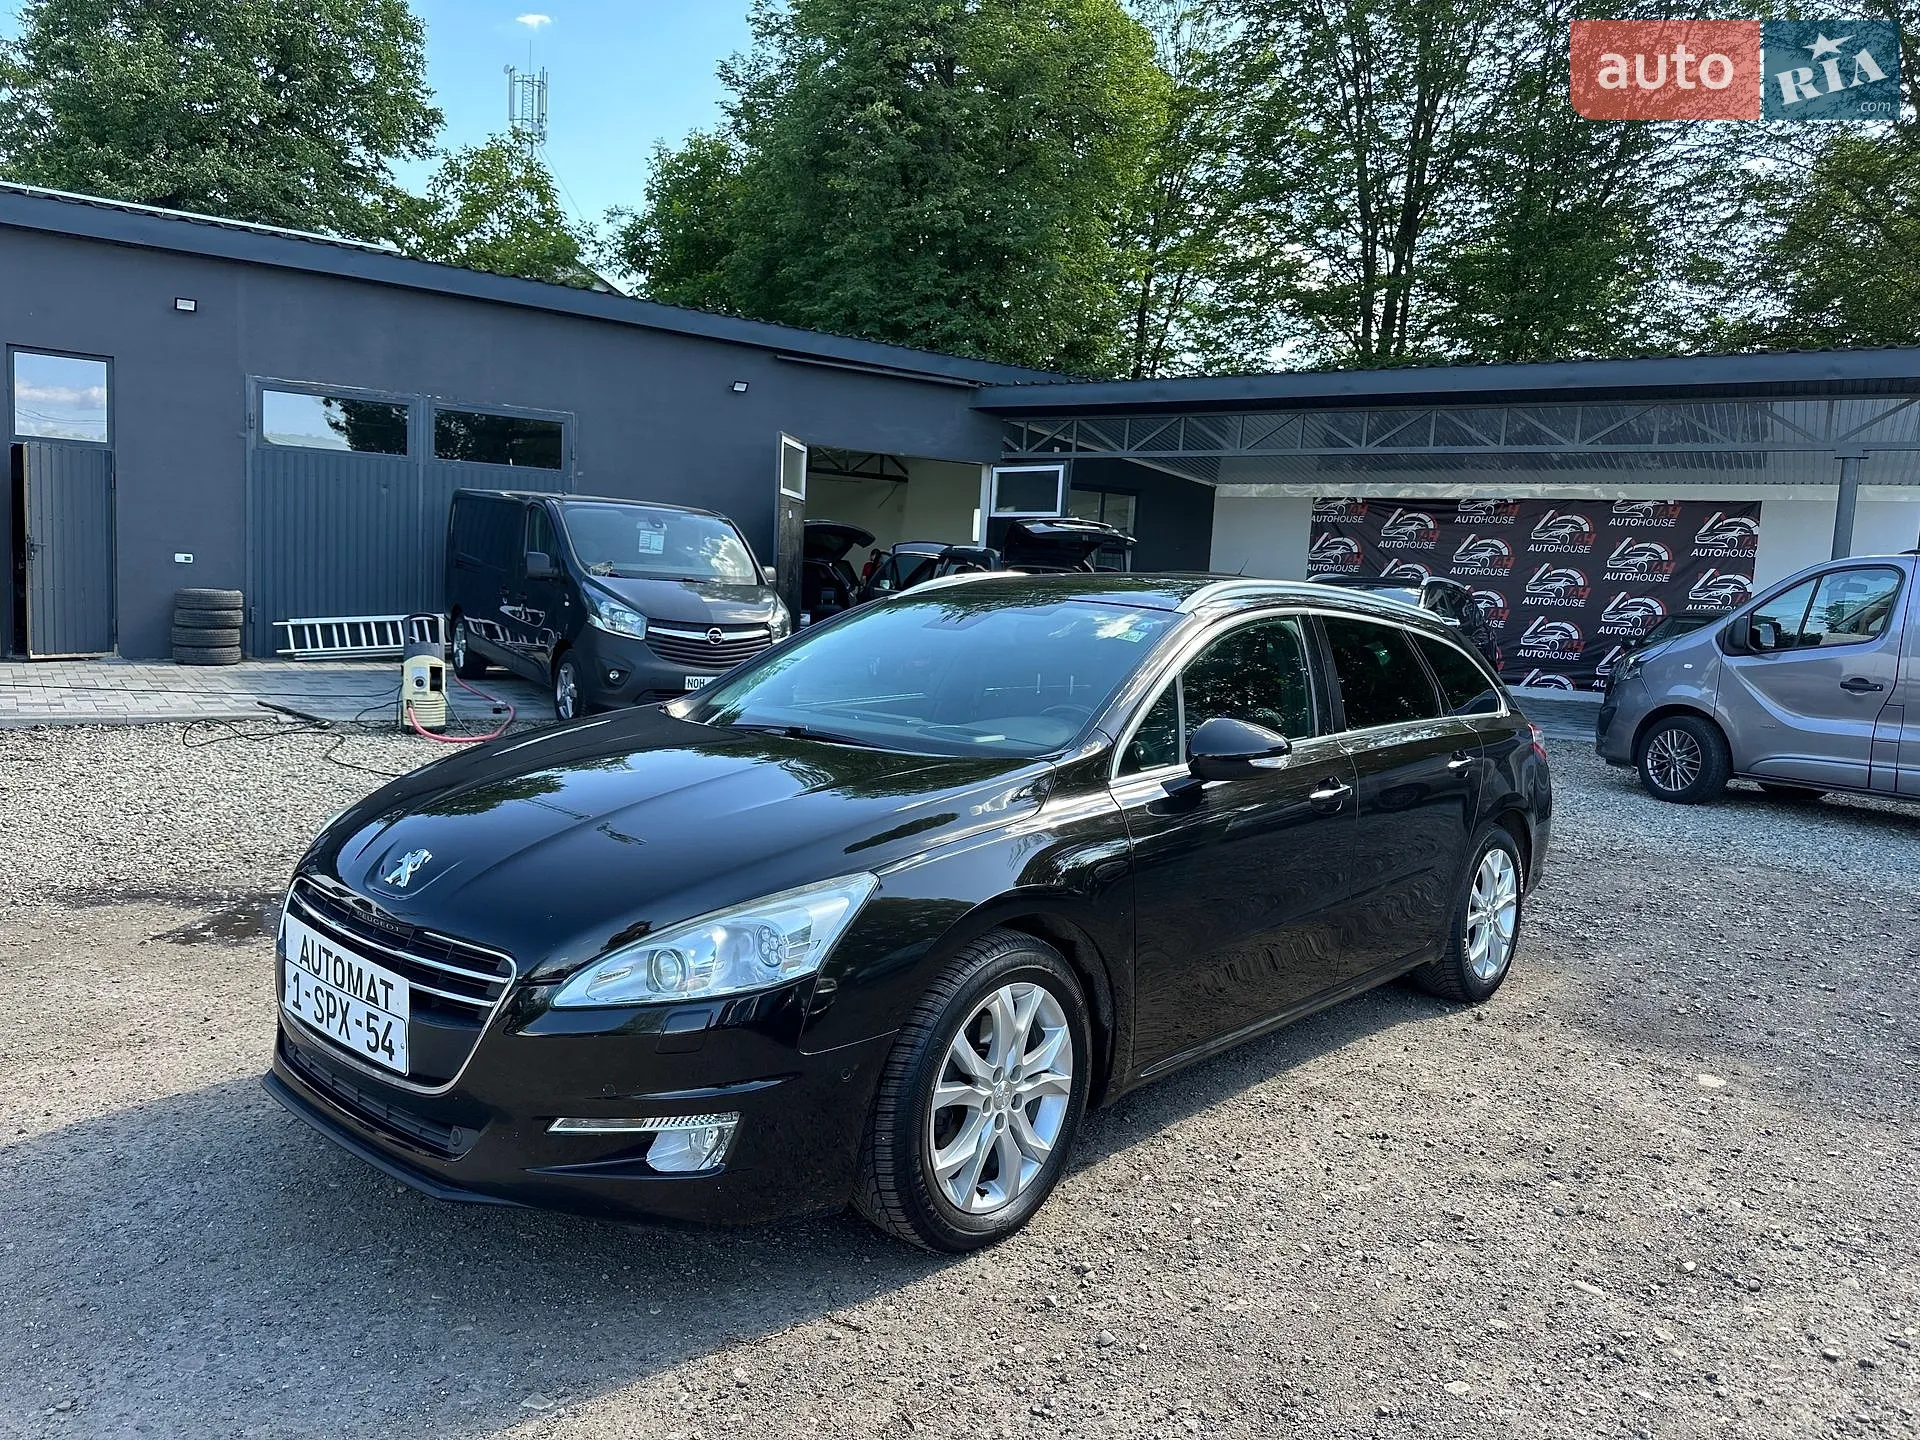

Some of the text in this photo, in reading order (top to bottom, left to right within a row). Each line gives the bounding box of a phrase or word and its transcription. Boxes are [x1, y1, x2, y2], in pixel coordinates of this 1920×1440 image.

[1454, 515, 1515, 525] AUTOHOUSE
[1608, 517, 1677, 528] AUTOHOUSE
[1378, 540, 1436, 549] AUTOHOUSE
[1527, 543, 1591, 554] AUTOHOUSE
[1690, 548, 1755, 558] AUTOHOUS
[1449, 566, 1510, 577] AUTOHOUSE
[1602, 572, 1671, 583] AUTOHOUSE
[1522, 596, 1586, 608] AUTOHOUSE
[1597, 626, 1646, 636] AUTOHO
[1517, 649, 1581, 661] AUTOHOUSE
[300, 934, 394, 1011] AUTOMAT
[292, 971, 395, 1061] 1-SPX-54
